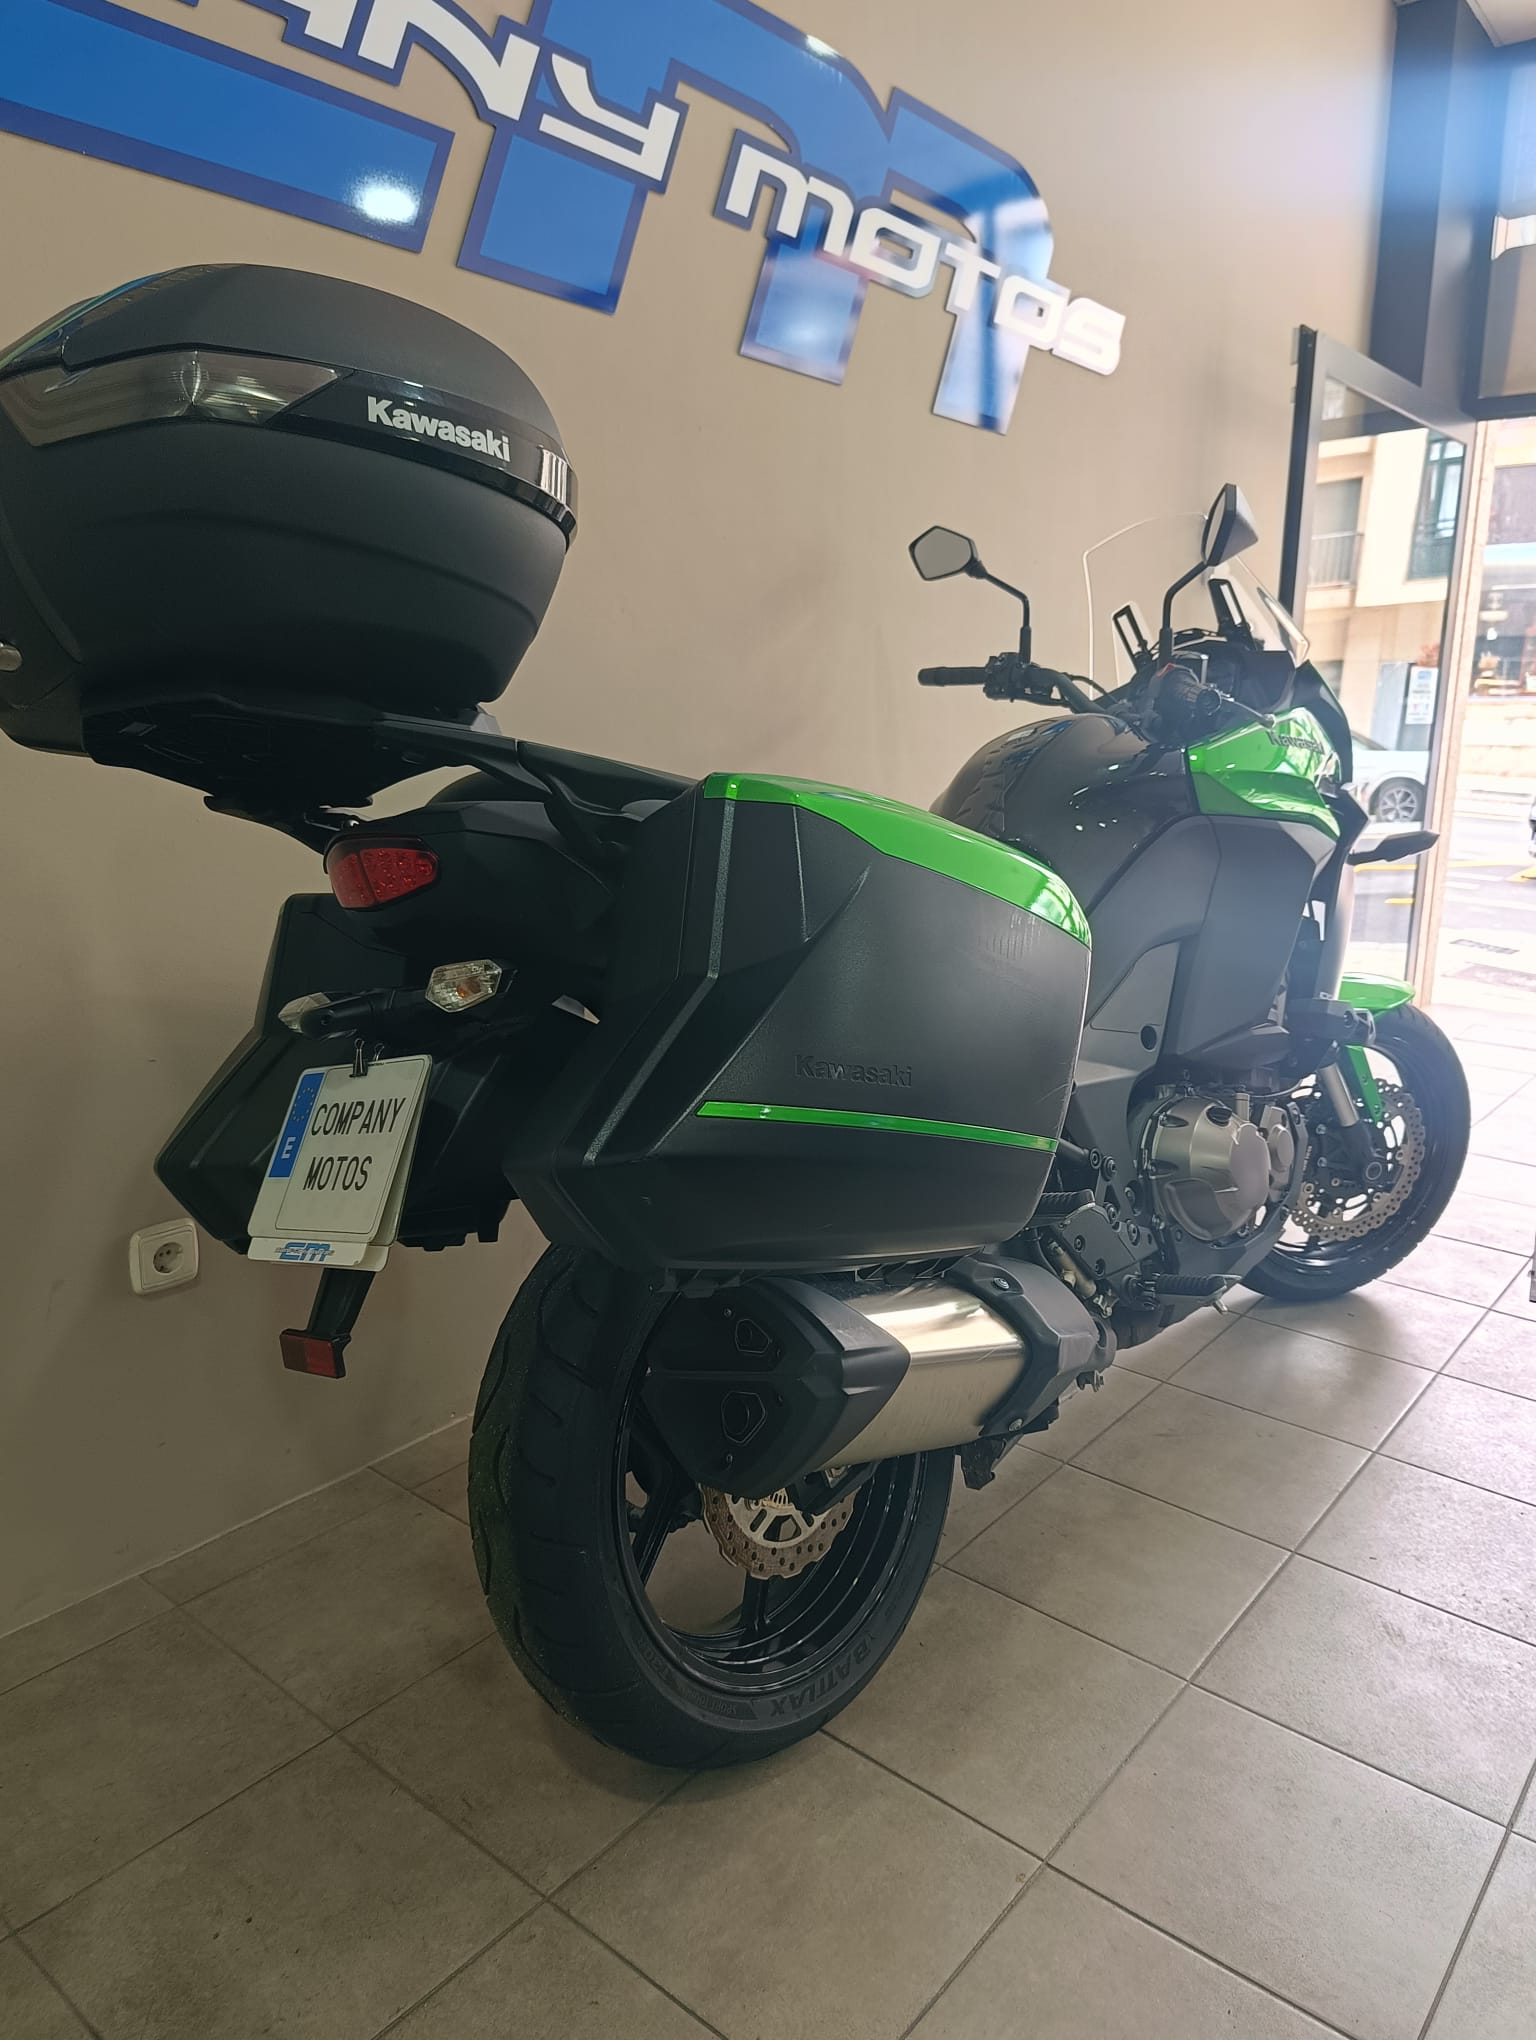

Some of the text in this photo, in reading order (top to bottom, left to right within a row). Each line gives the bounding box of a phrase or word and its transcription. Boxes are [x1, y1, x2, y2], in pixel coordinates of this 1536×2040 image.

[367, 395, 511, 462] Kawasaki
[794, 1054, 913, 1088] Kawasaki
[310, 1097, 407, 1136] COMPANY
[281, 1136, 297, 1160] E
[302, 1155, 373, 1191] MOTOS
